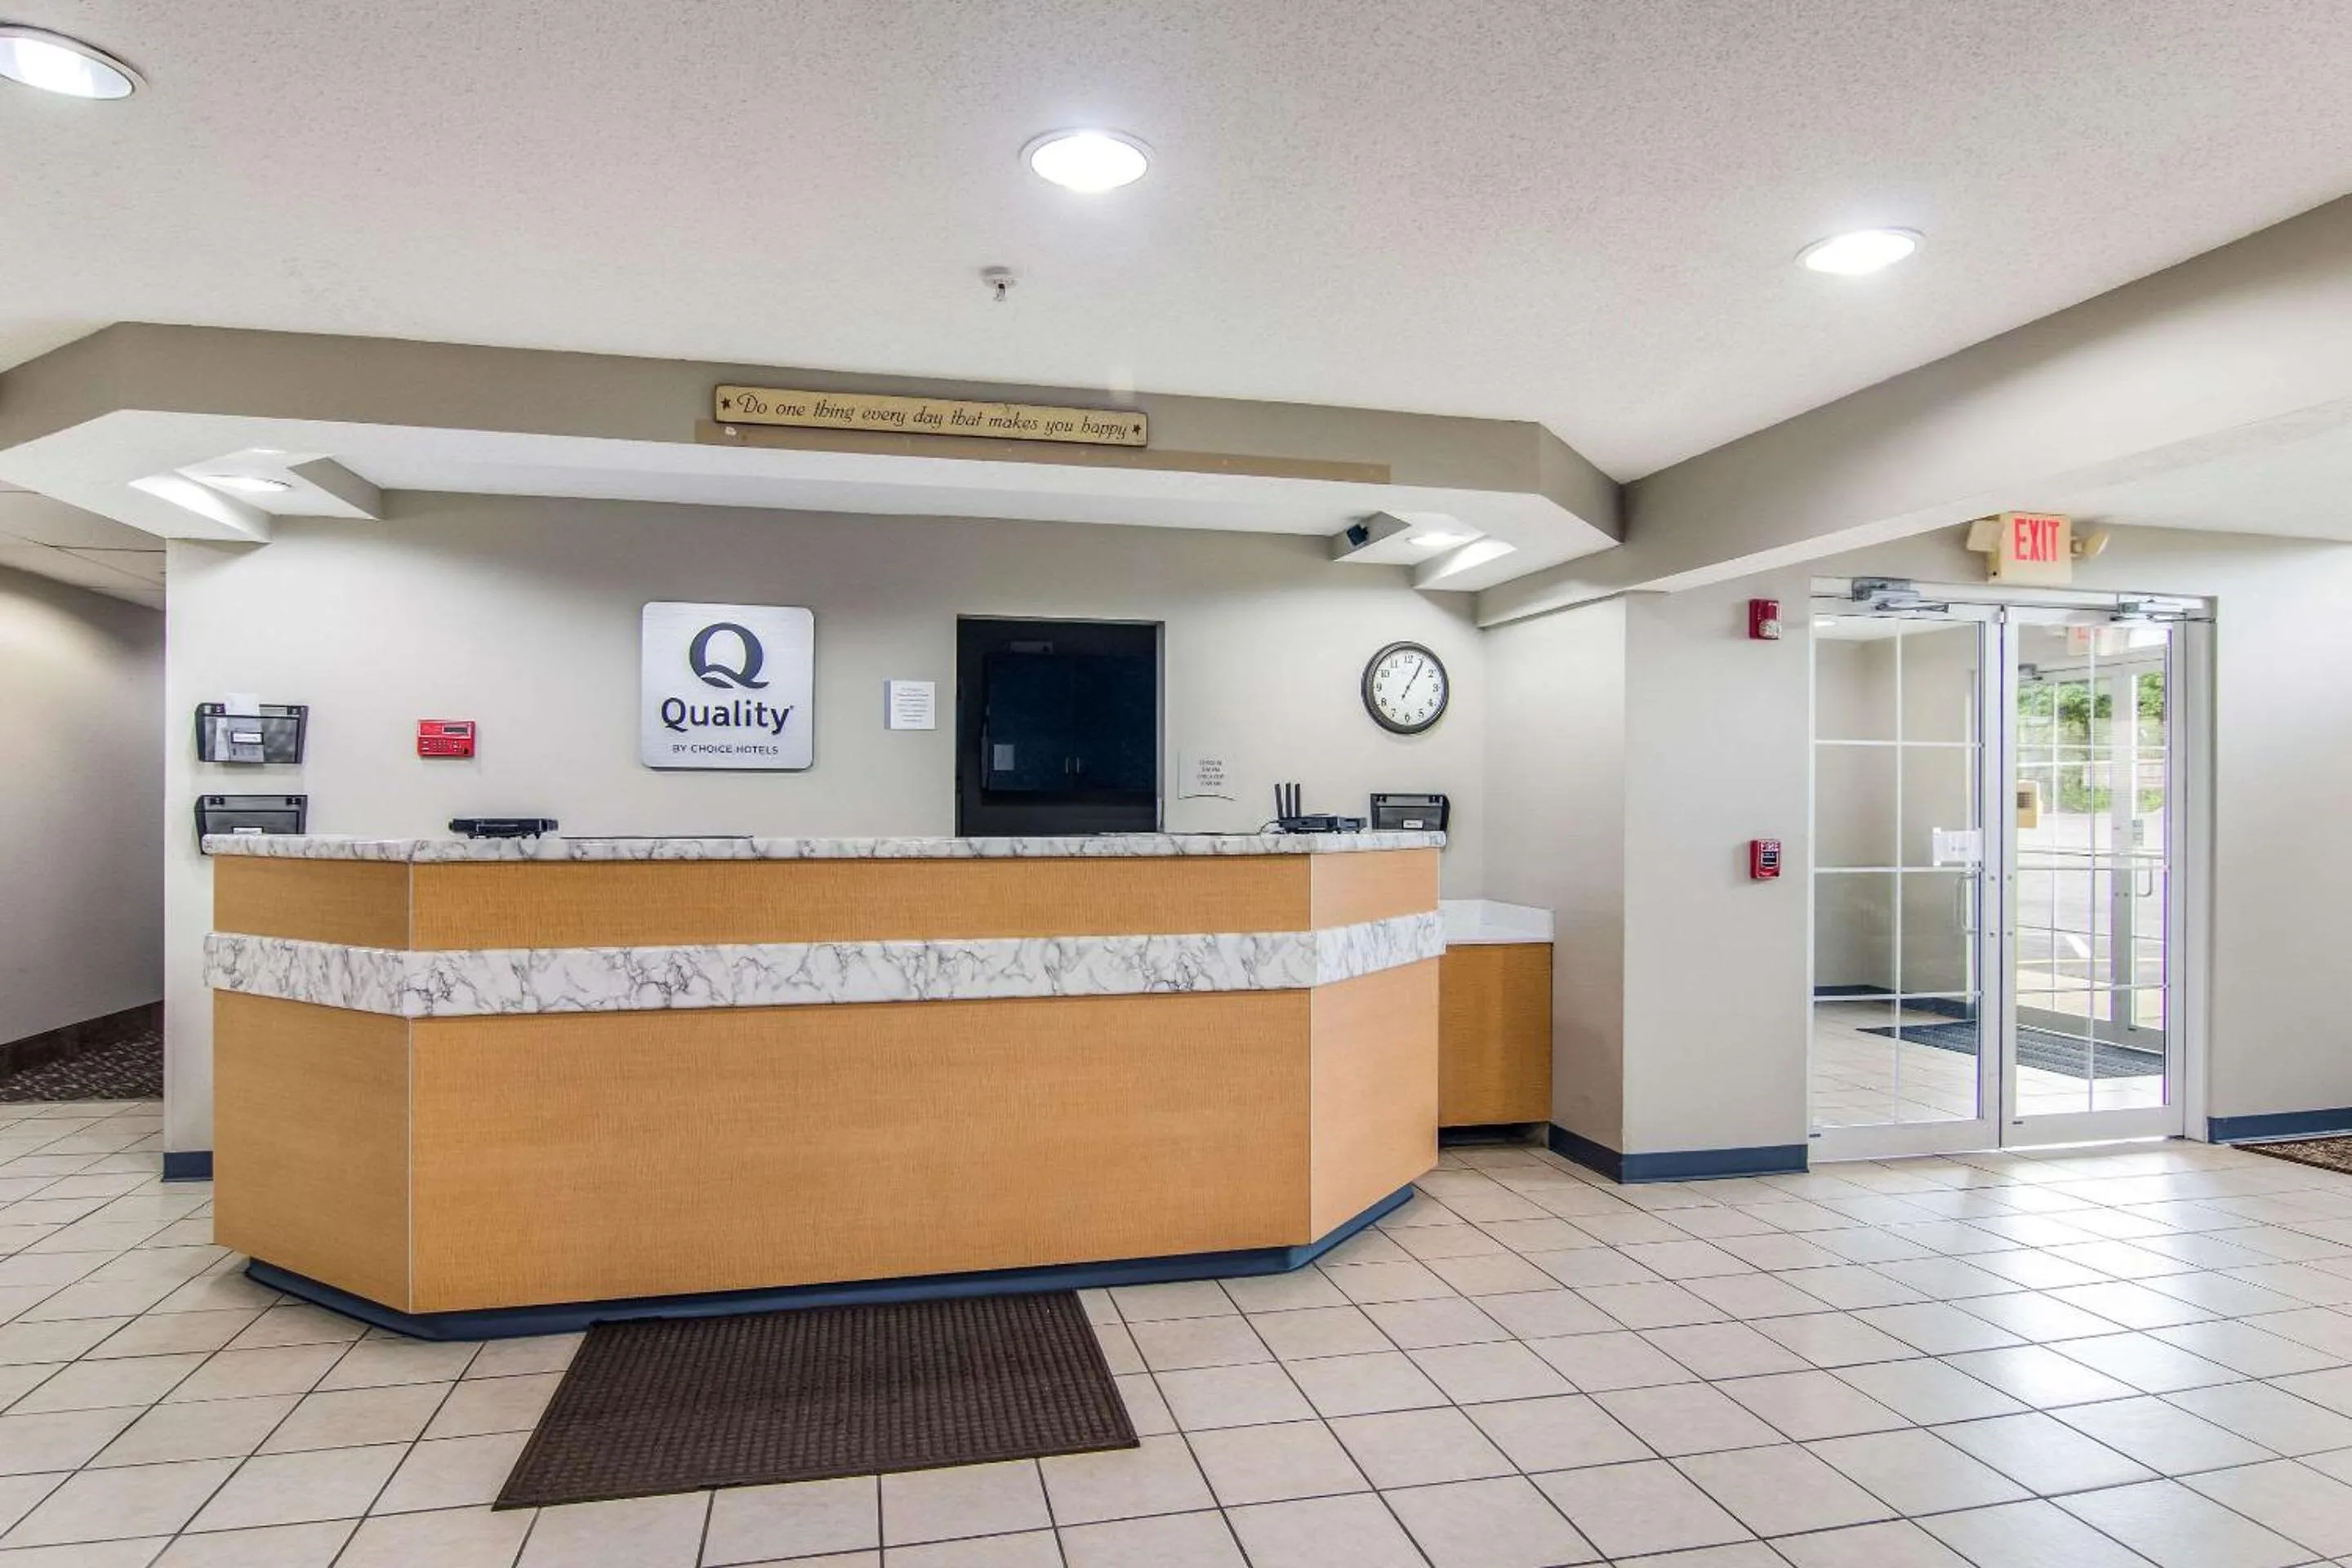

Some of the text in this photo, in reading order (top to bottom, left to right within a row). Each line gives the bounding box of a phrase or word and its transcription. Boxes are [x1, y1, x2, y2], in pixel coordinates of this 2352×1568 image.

[737, 392, 1128, 439] Do one thing every day that makes you happy
[2014, 519, 2060, 562] EXIT
[689, 622, 770, 688] Q
[1404, 655, 1414, 664] 12
[1380, 669, 1390, 678] 10
[1428, 669, 1434, 678] 2
[1376, 683, 1383, 692] 9
[1432, 684, 1439, 693] 3
[1380, 697, 1387, 706] 8
[1427, 698, 1434, 707] 4
[661, 697, 791, 736] Quality
[1390, 708, 1396, 717] 7
[1418, 708, 1424, 718] 5
[1404, 713, 1410, 723] 6
[672, 744, 778, 755] BY CHOICE HOTELS
